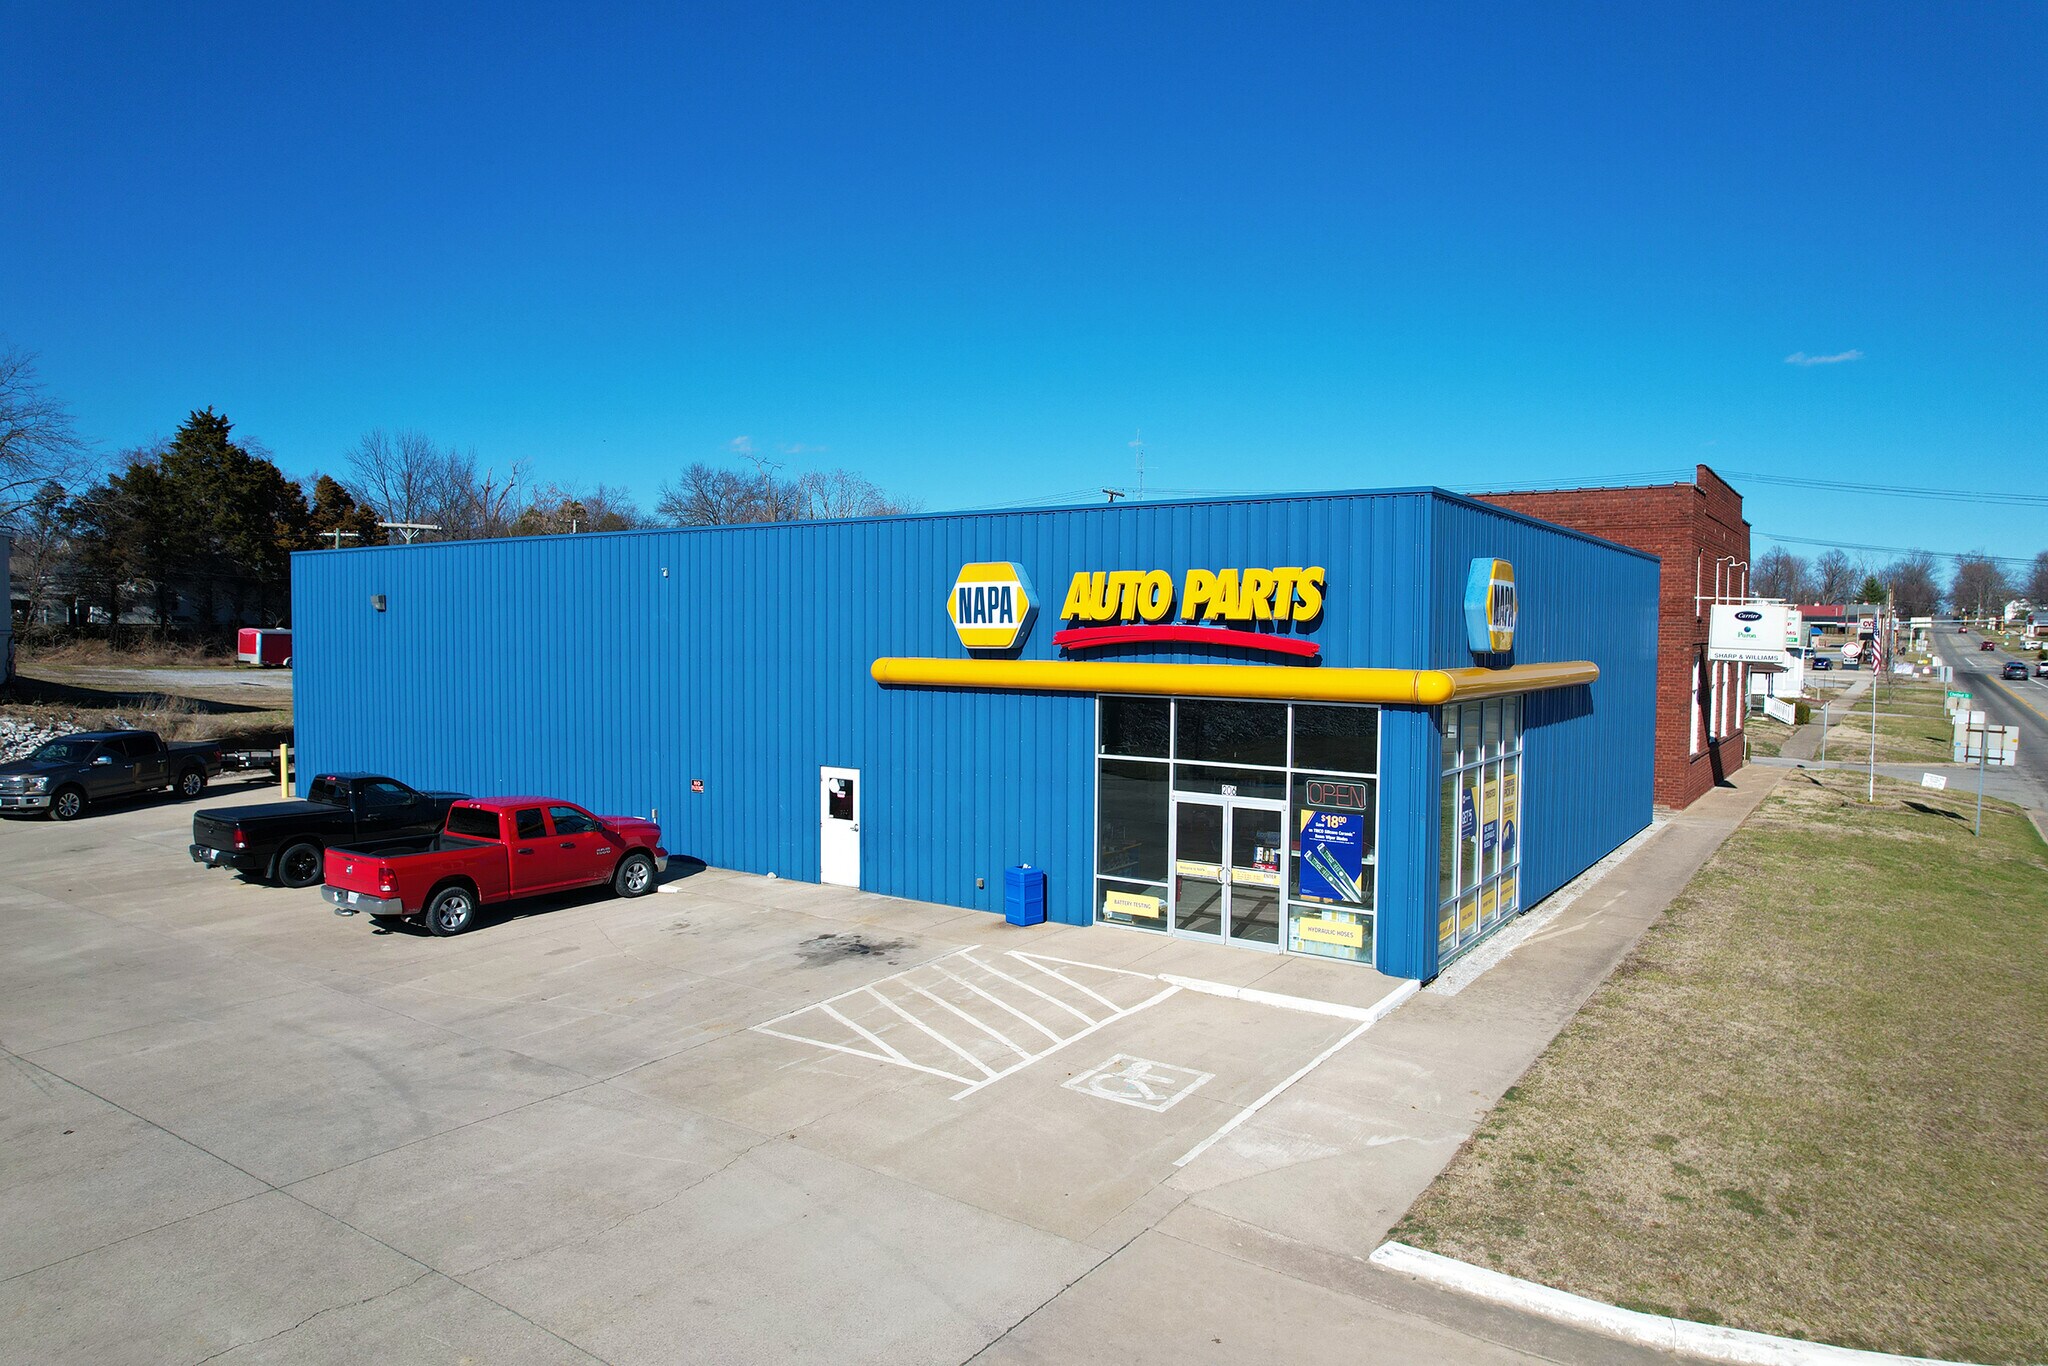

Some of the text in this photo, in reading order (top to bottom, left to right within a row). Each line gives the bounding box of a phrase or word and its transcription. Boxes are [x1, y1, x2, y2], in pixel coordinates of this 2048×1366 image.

[959, 586, 1013, 625] NAPA
[1060, 566, 1326, 621] AUTO PARTS
[1493, 584, 1514, 628] NAPA
[1309, 782, 1364, 808] OPEN
[1114, 899, 1132, 907] BATTERY
[1308, 926, 1354, 938] HYDRAULIC HOSES
